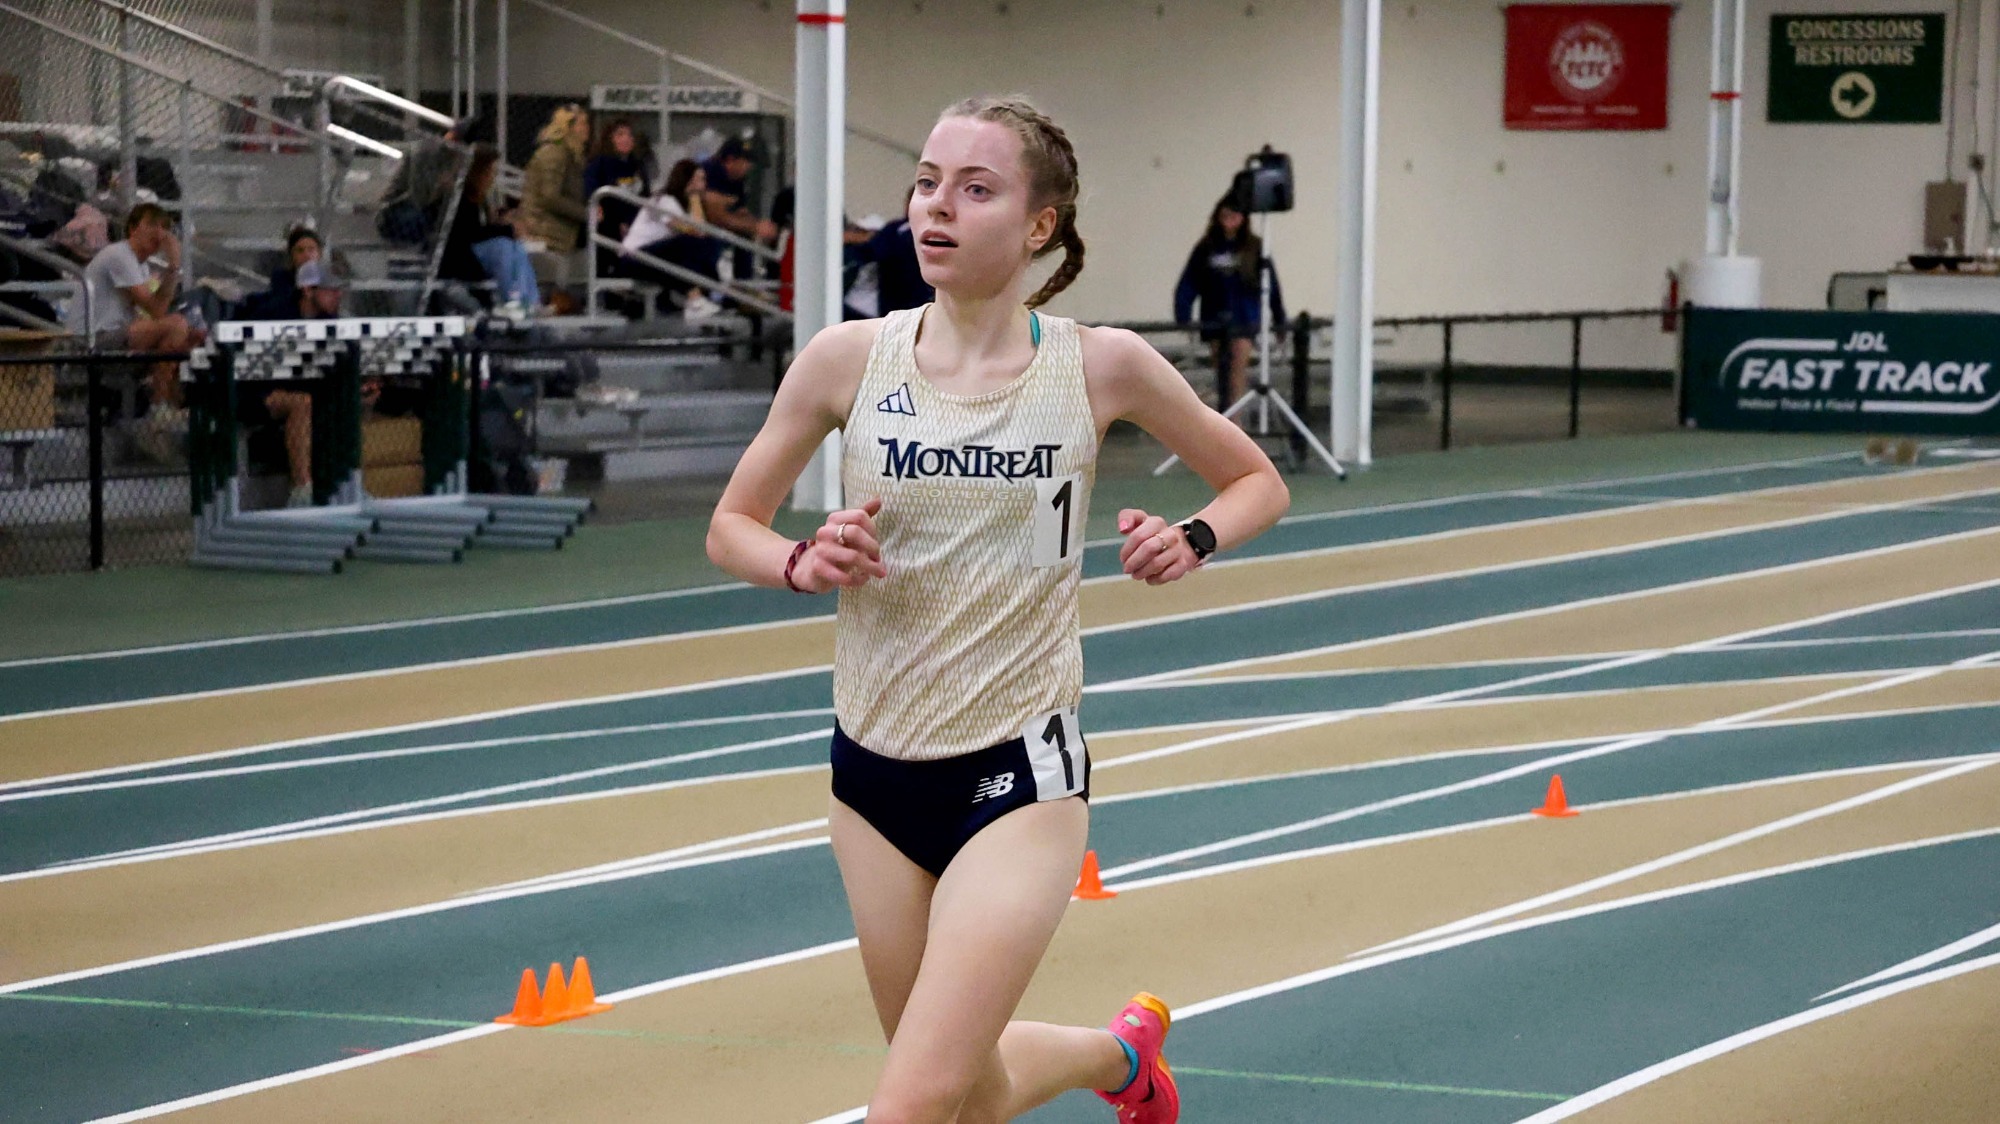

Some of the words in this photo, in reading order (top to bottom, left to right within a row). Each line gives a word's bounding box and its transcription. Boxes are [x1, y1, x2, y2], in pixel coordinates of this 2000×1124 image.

[1787, 20, 1926, 40] CONCESSIONS
[1795, 45, 1915, 66] RESTROOMS
[1843, 331, 1889, 352] JDL
[1738, 358, 1844, 391] FAST
[1855, 360, 1991, 394] TRACK
[878, 437, 1062, 484] MONTREAT
[910, 488, 1028, 500] COLLEGE
[1051, 480, 1073, 559] 1
[1041, 713, 1075, 791] 1
